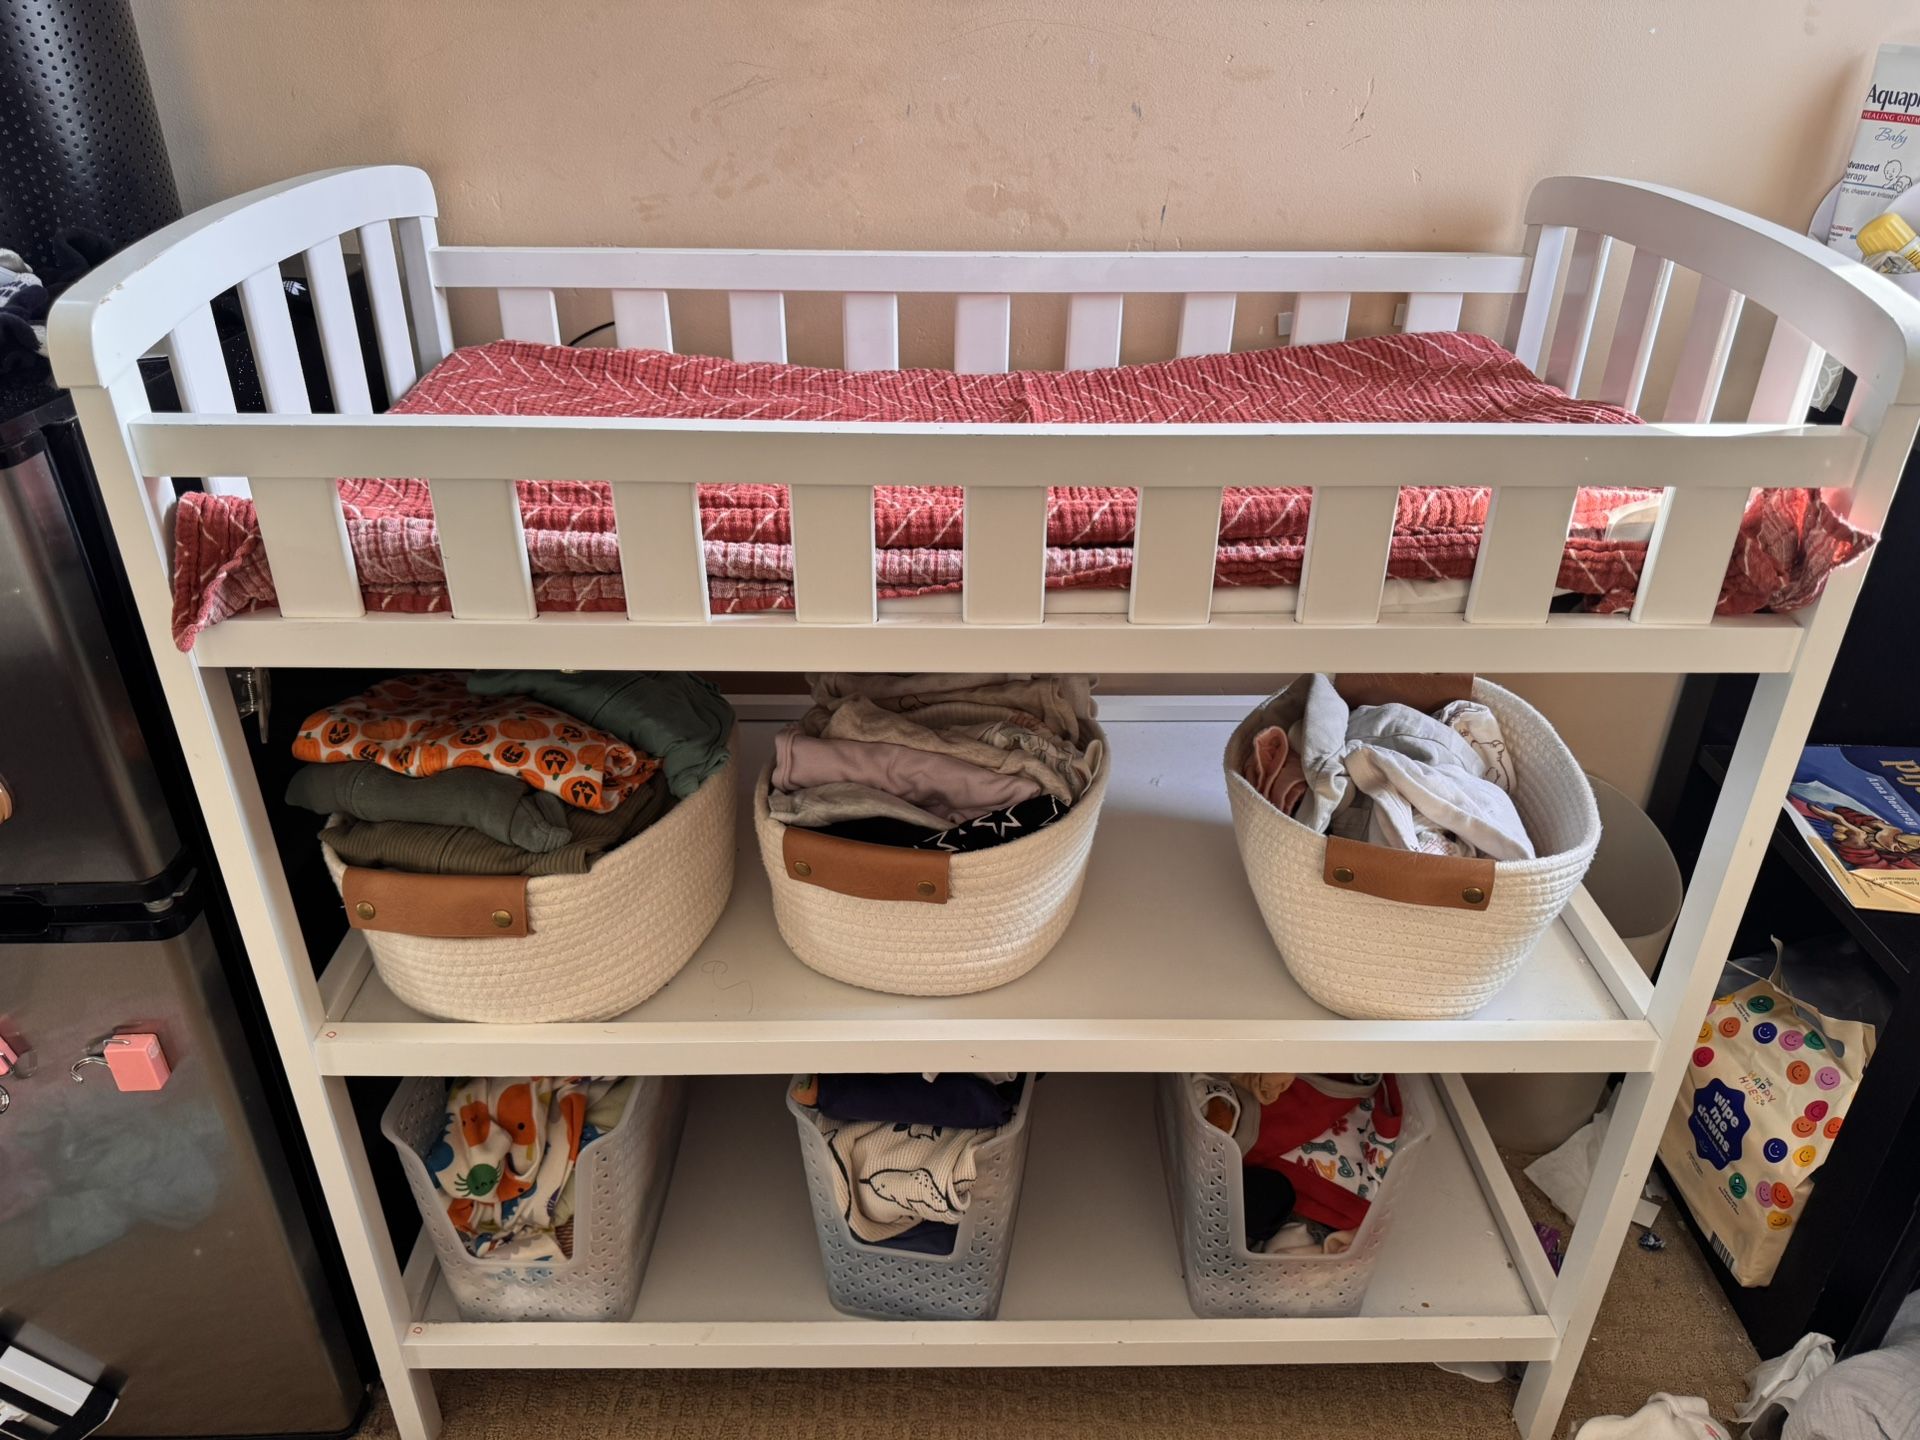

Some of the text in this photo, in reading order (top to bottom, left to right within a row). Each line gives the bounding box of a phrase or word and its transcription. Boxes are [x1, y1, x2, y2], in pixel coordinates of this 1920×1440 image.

[1862, 111, 1896, 121] HEALING
[1874, 126, 1909, 150] Baby
[1866, 777, 1888, 795] Anna
[1748, 1070, 1776, 1103] HAPPY
[1710, 1106, 1728, 1133] me
[1713, 1091, 1740, 1129] wipe
